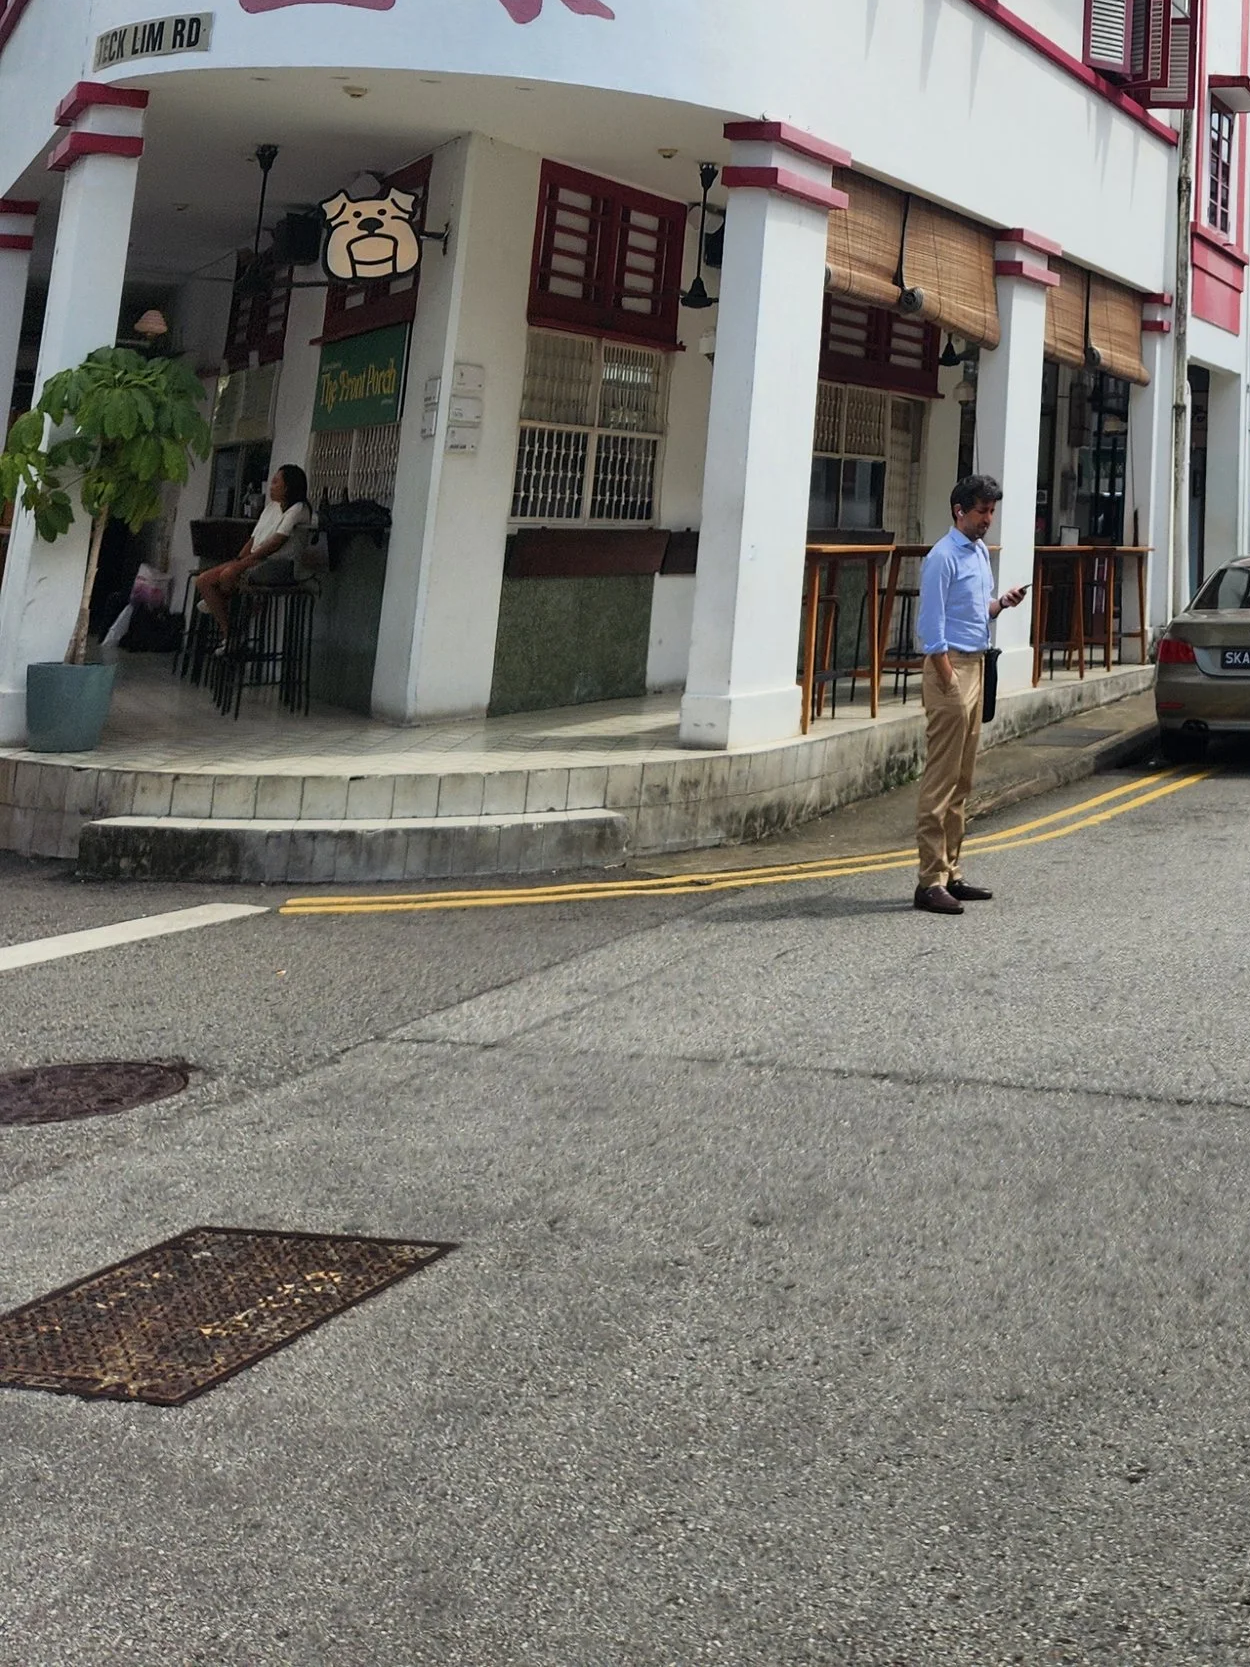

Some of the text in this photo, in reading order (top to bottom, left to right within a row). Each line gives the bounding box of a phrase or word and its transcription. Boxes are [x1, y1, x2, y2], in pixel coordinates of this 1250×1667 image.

[97, 17, 201, 66] TECK LIM RD
